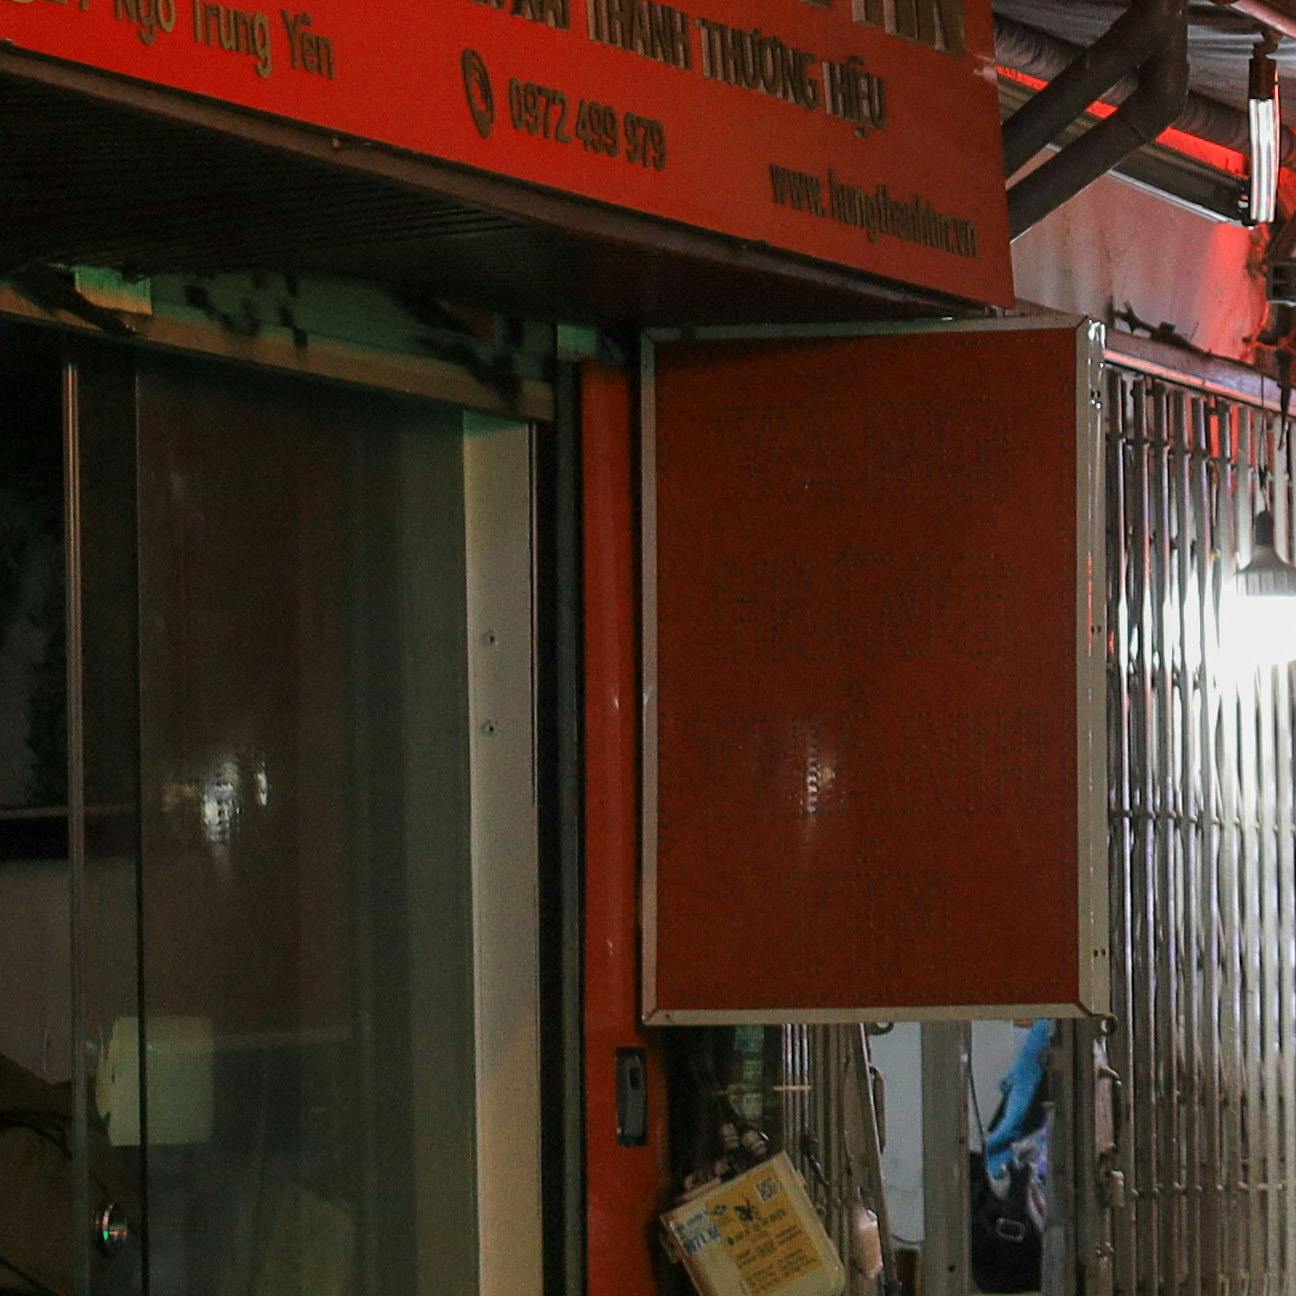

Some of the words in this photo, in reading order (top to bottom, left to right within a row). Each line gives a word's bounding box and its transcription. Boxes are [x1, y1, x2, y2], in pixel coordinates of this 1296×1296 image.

[281, 6, 337, 80] Yên
[509, 76, 574, 145] 0972
[821, 55, 889, 140] HIỆU
